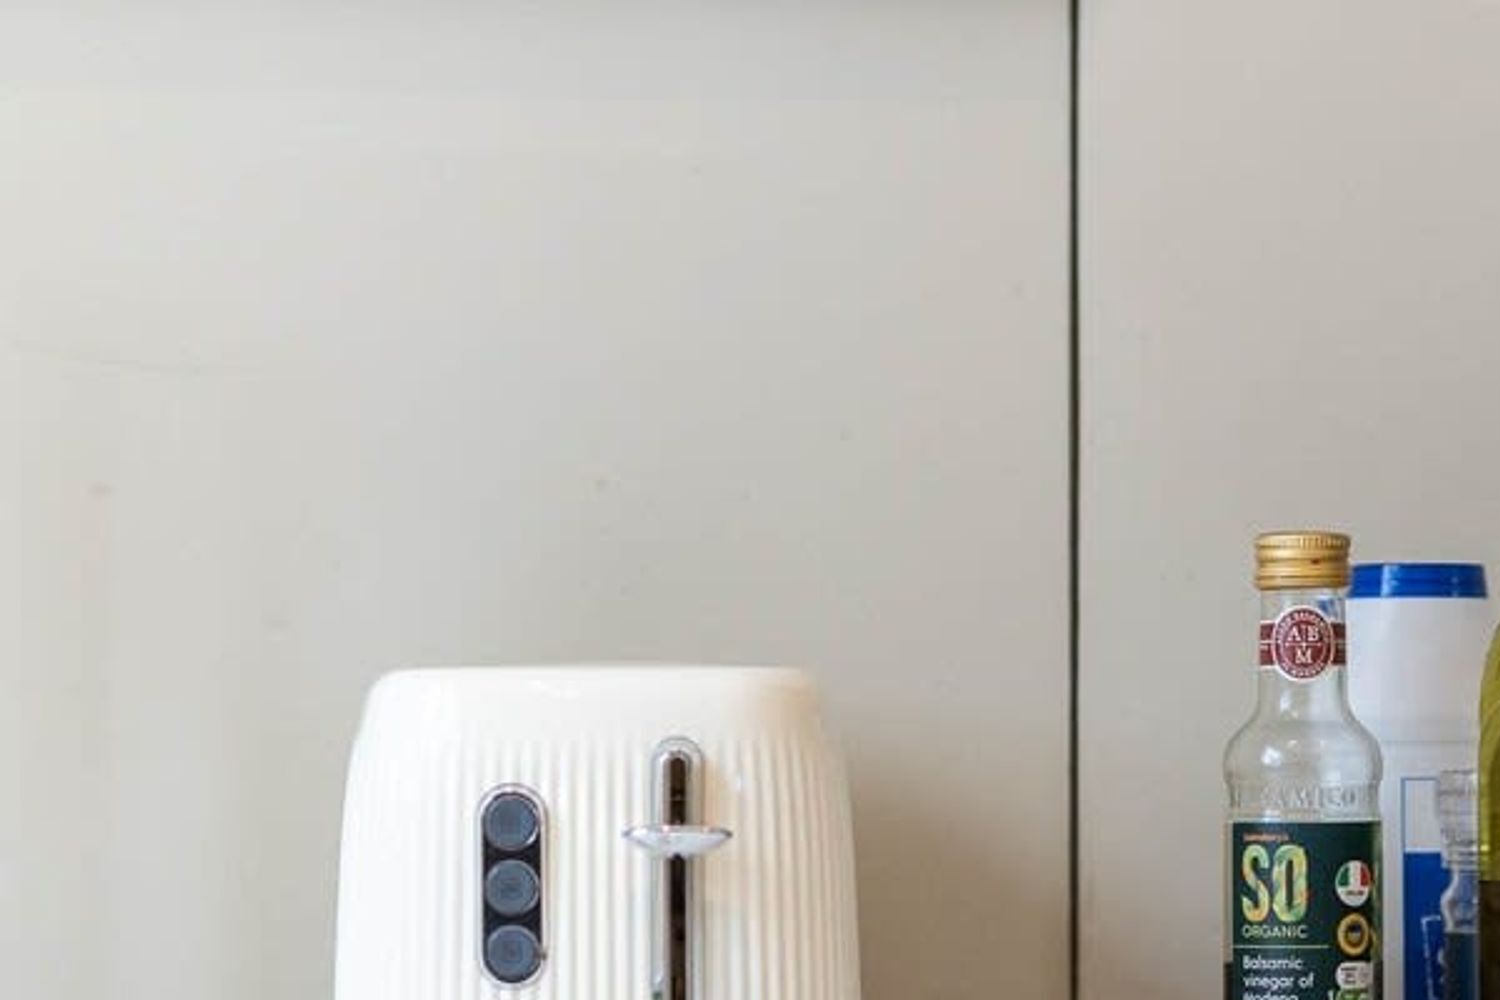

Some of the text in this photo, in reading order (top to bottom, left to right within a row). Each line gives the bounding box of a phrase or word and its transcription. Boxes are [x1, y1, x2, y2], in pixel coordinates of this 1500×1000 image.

[1241, 844, 1308, 922] SO
[1241, 924, 1309, 939] ORGANIC
[1242, 954, 1303, 970] Balsamic
[1242, 972, 1315, 991] vinegar of
